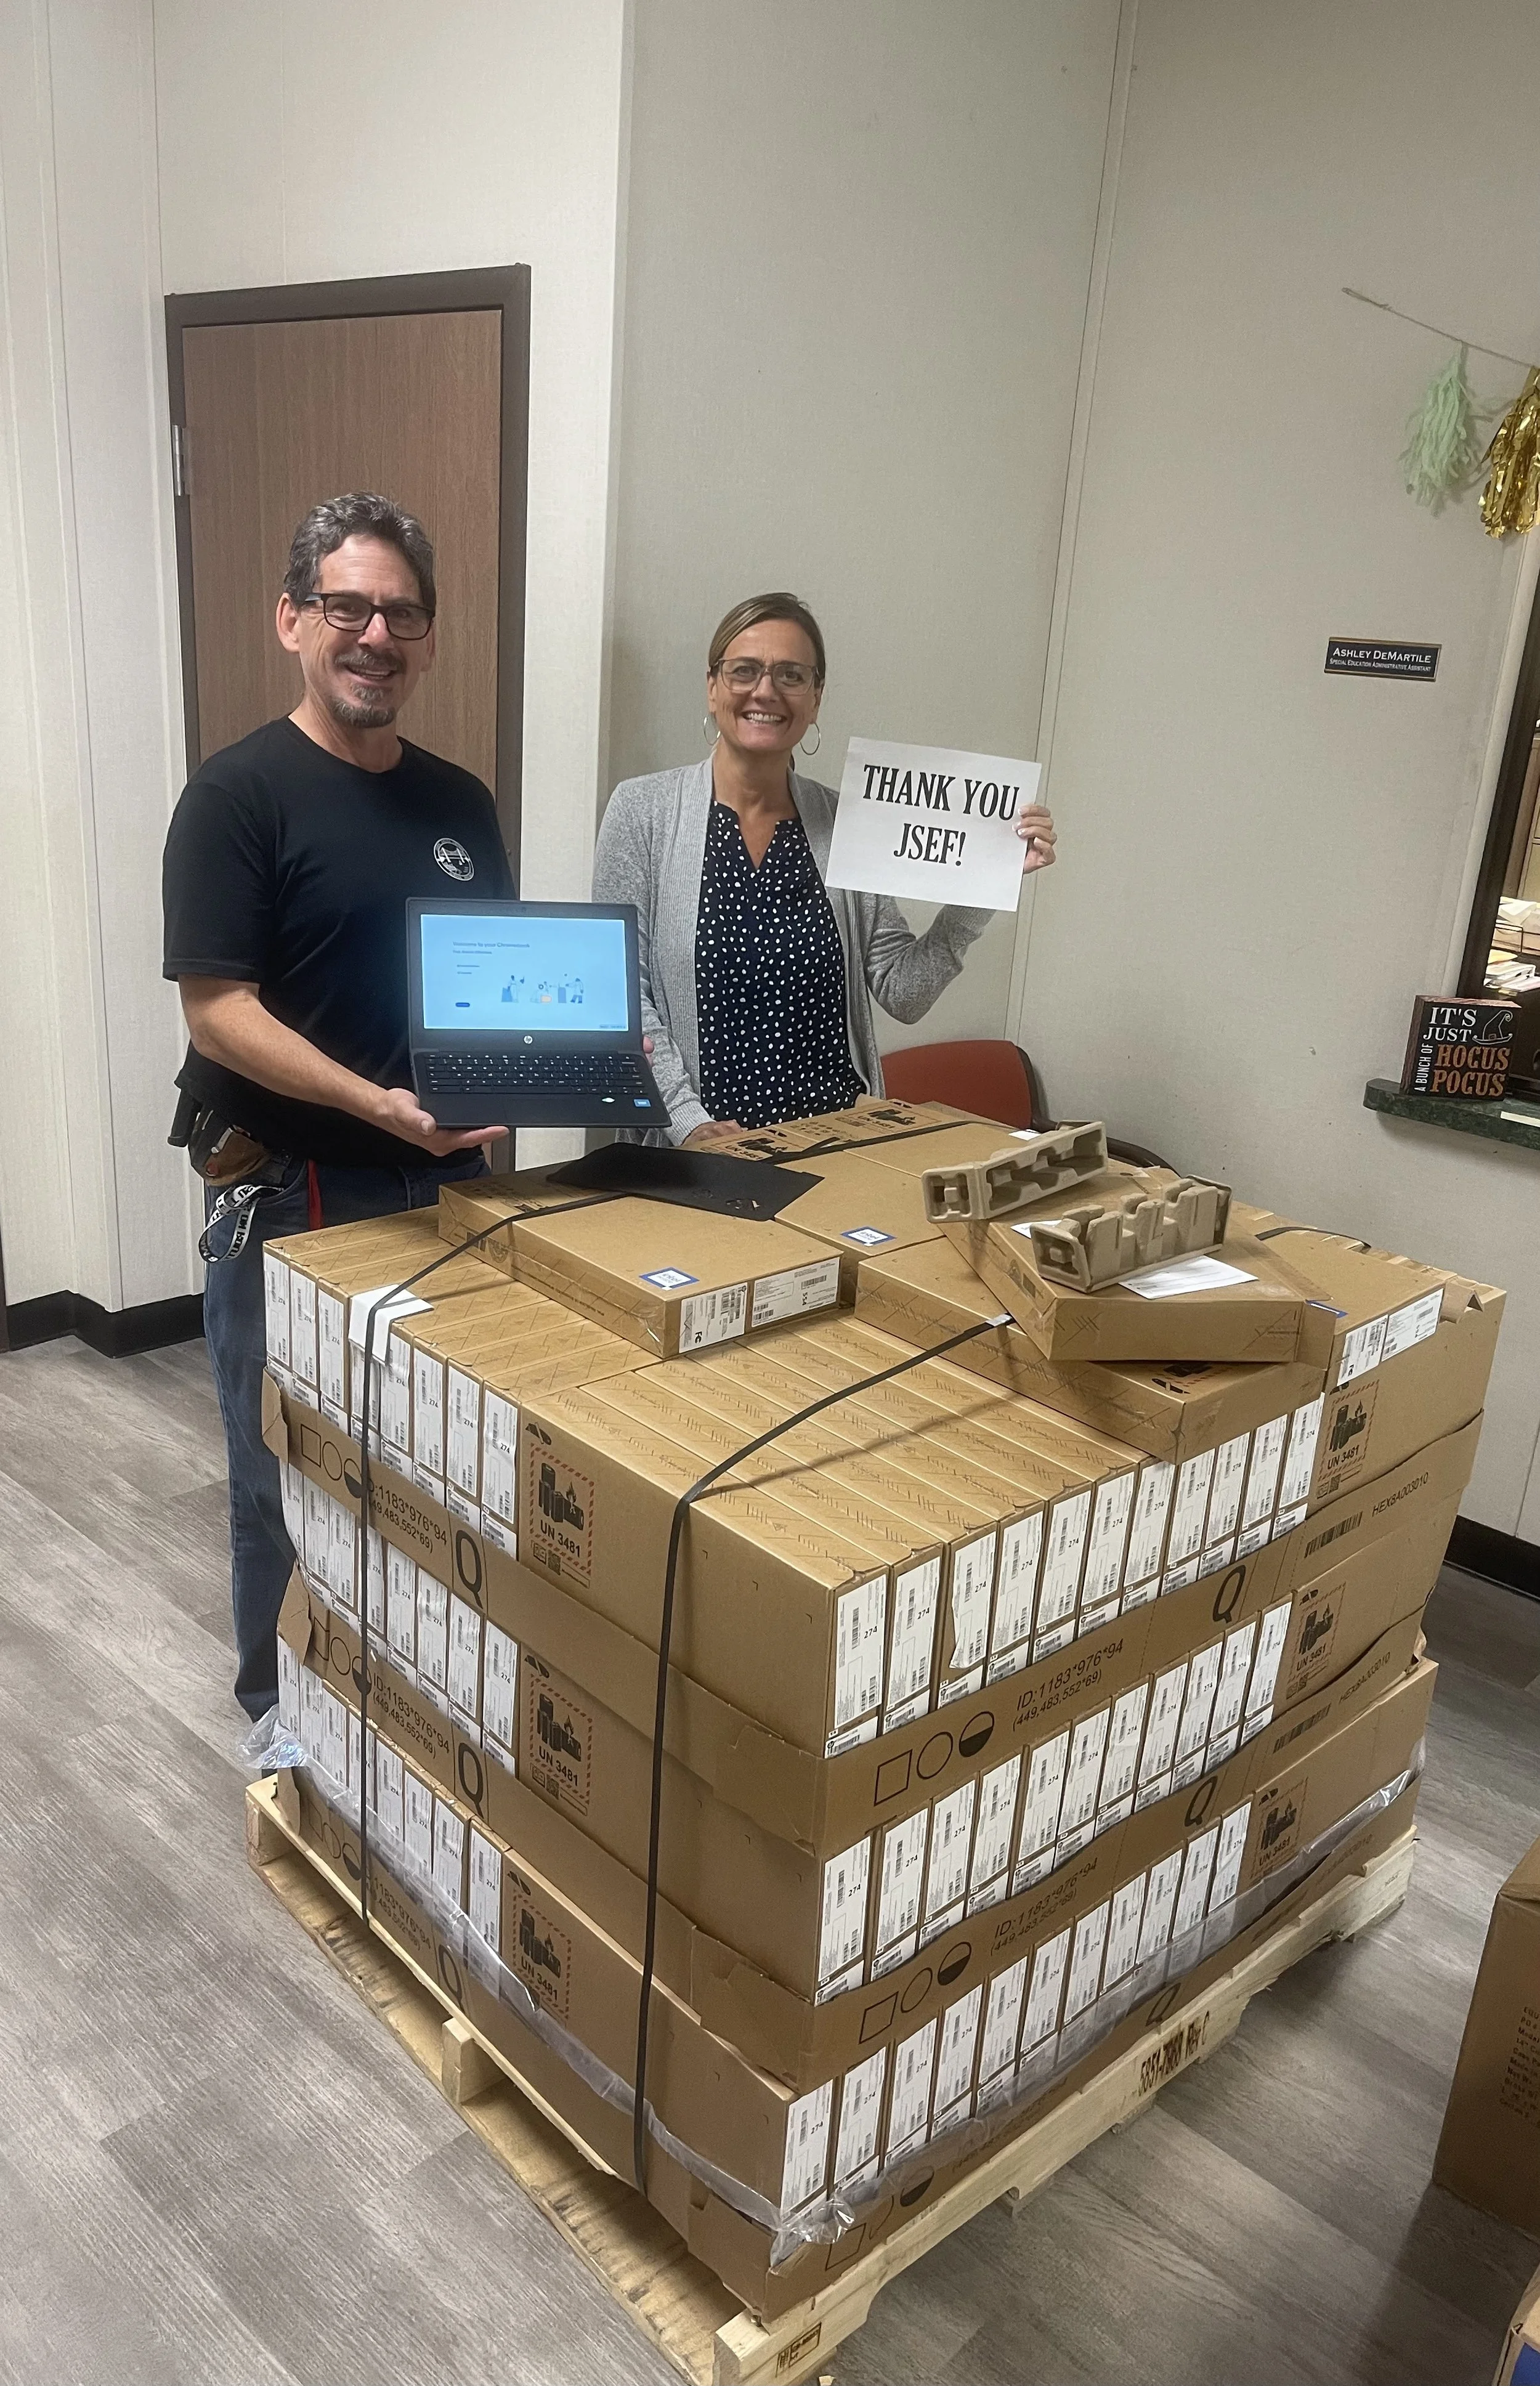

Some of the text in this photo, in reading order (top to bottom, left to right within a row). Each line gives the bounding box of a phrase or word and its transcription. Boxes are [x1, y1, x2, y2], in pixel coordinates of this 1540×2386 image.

[1332, 647, 1372, 659] ASHLEY
[1372, 662, 1407, 670] ADMINISTRATIVE
[863, 764, 1020, 821] THANK YOU
[893, 822, 967, 866] JSEF!
[1429, 1007, 1477, 1026] IT'S
[1421, 1043, 1433, 1054] OF
[1423, 1027, 1472, 1042] JUST
[1416, 1057, 1432, 1084] BUNCH
[1434, 1044, 1510, 1071] HOCUS
[1429, 1069, 1506, 1097] POCUS
[1327, 1445, 1359, 1470] UN 3481
[541, 1520, 580, 1558] UN 3481
[455, 1530, 483, 1609] Q
[1212, 1565, 1246, 1624] Q
[458, 1742, 484, 1819] Q
[539, 1745, 578, 1787] UN 3481
[1185, 1775, 1218, 1828] Q
[521, 1956, 557, 2001] UN 3481
